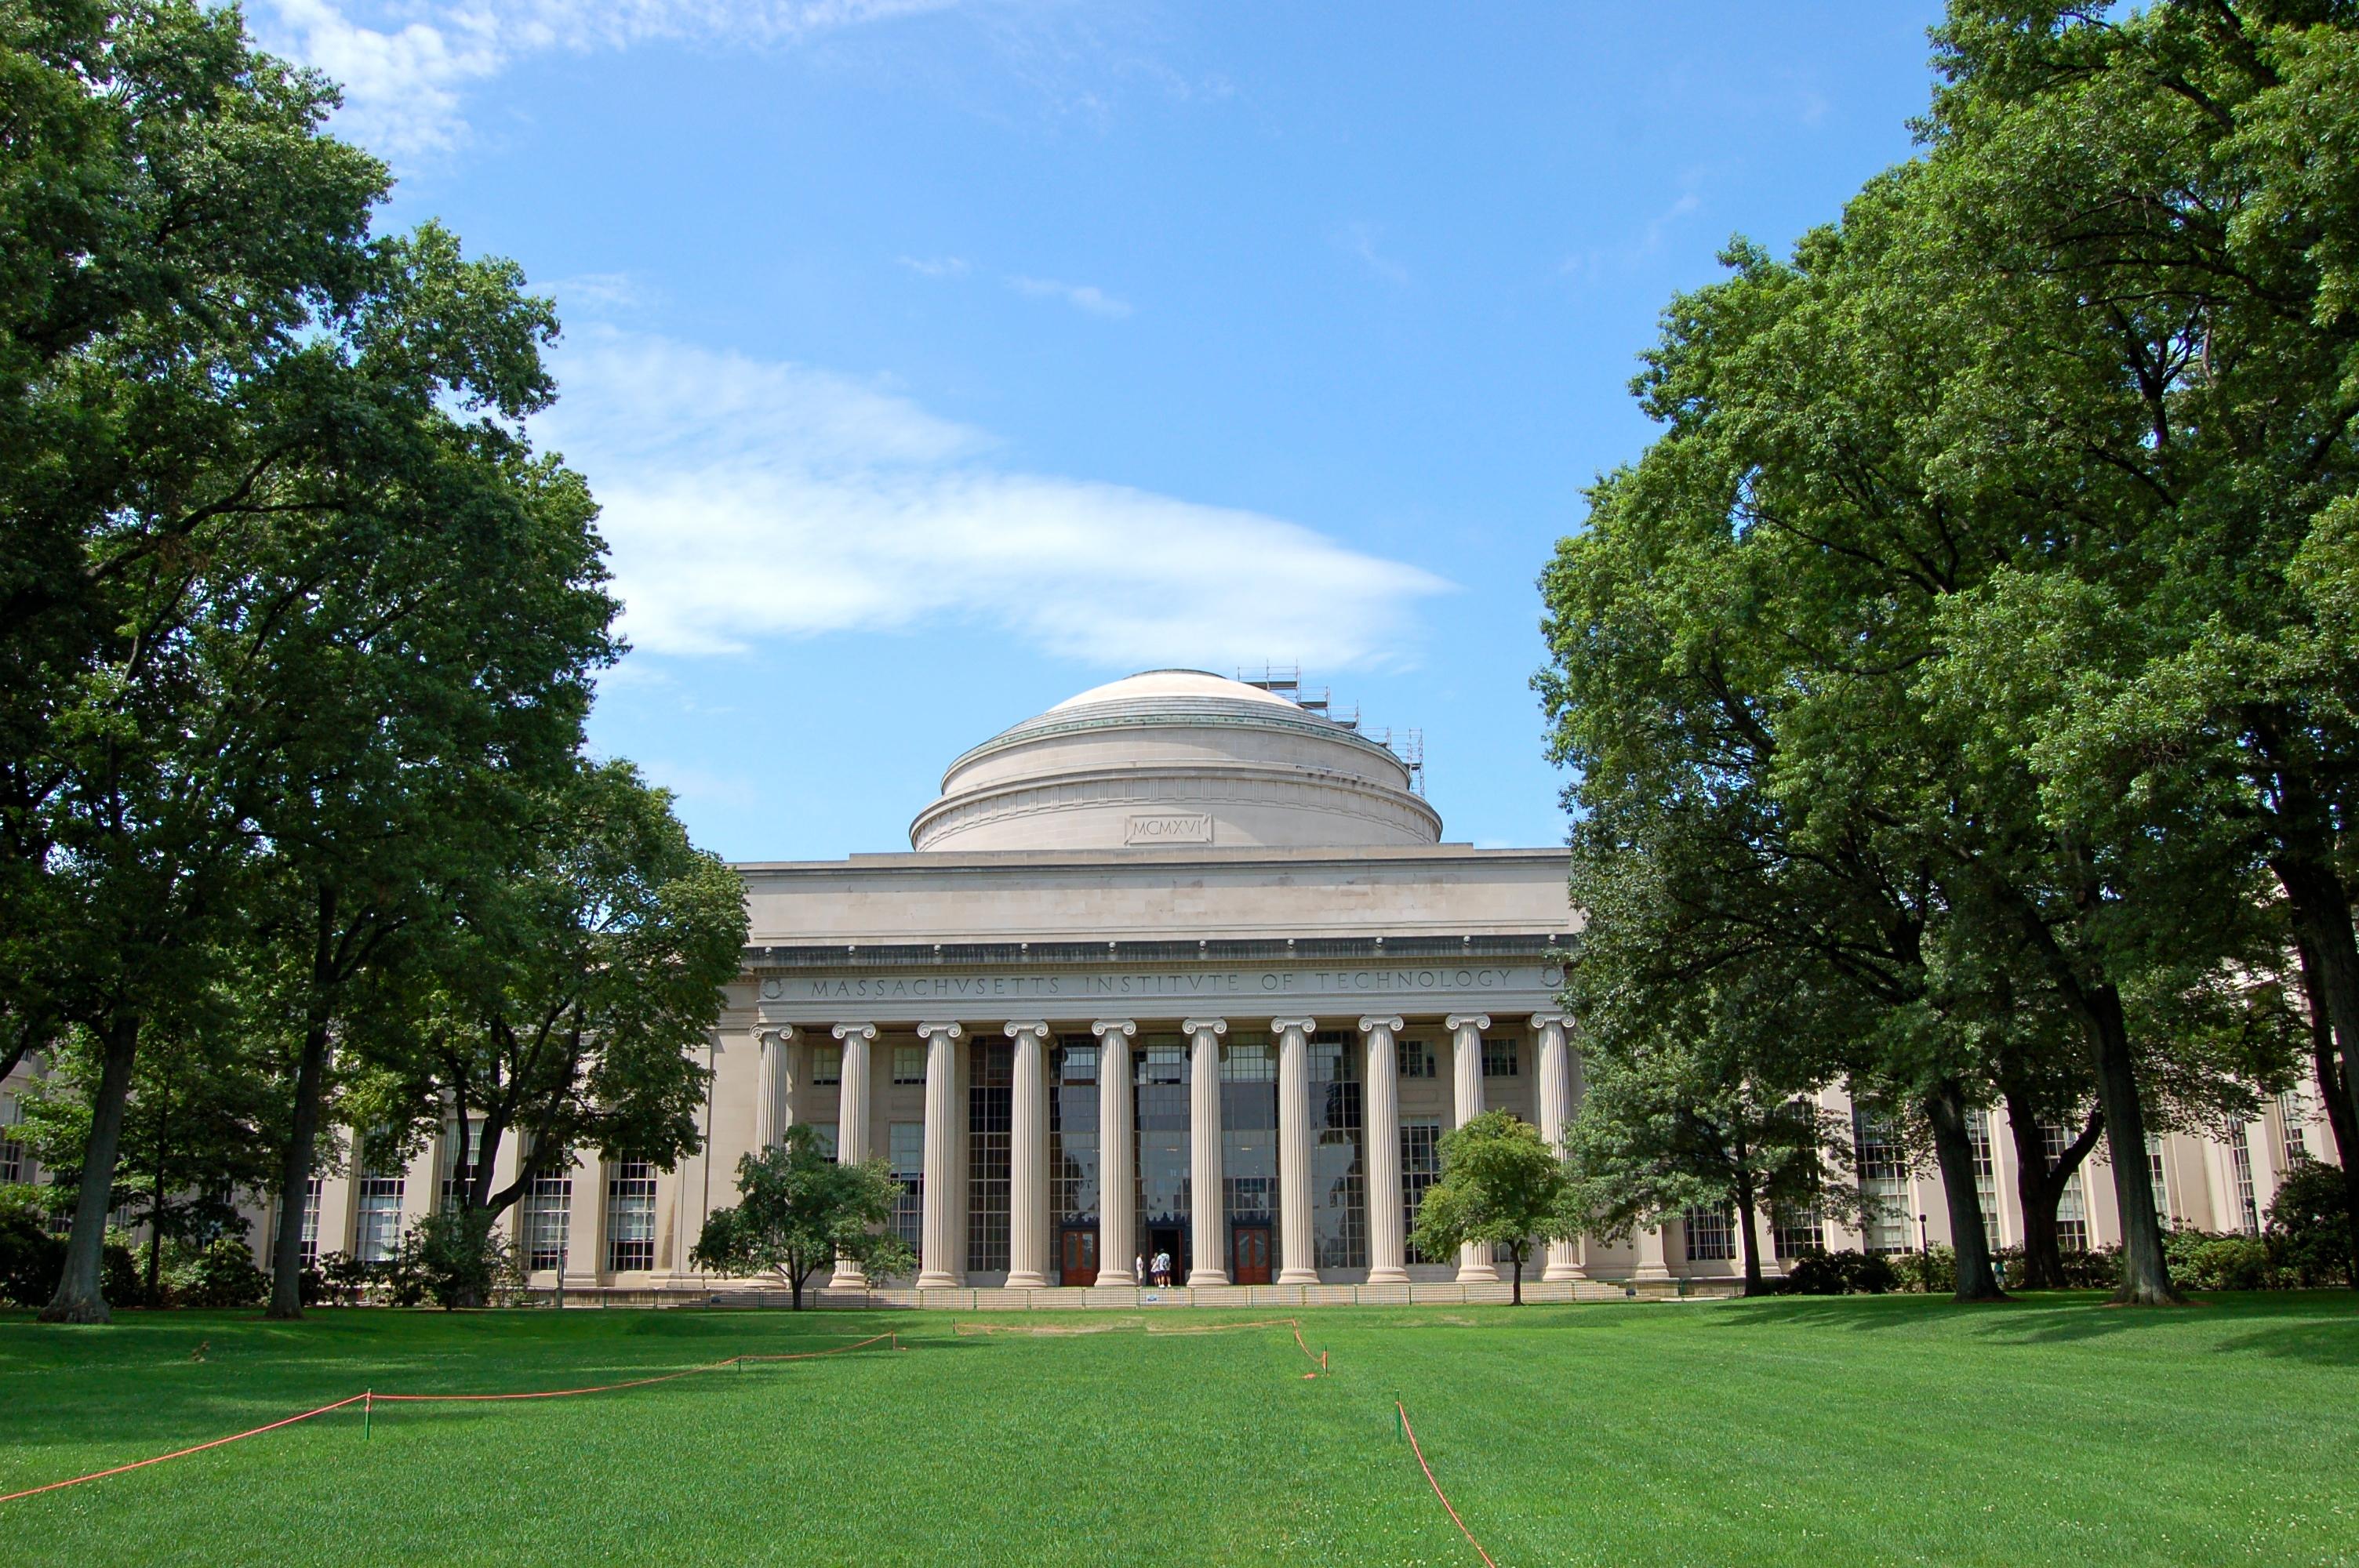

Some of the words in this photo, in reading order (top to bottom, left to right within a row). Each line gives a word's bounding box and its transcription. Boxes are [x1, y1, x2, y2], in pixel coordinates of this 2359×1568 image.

[1132, 819, 1201, 836] MCMXVI
[811, 977, 1060, 996] MASSACHVSETTS
[1085, 974, 1239, 993] INSTITVTE
[1261, 973, 1293, 991] OF
[1316, 969, 1512, 989] TECHNOLOGY
